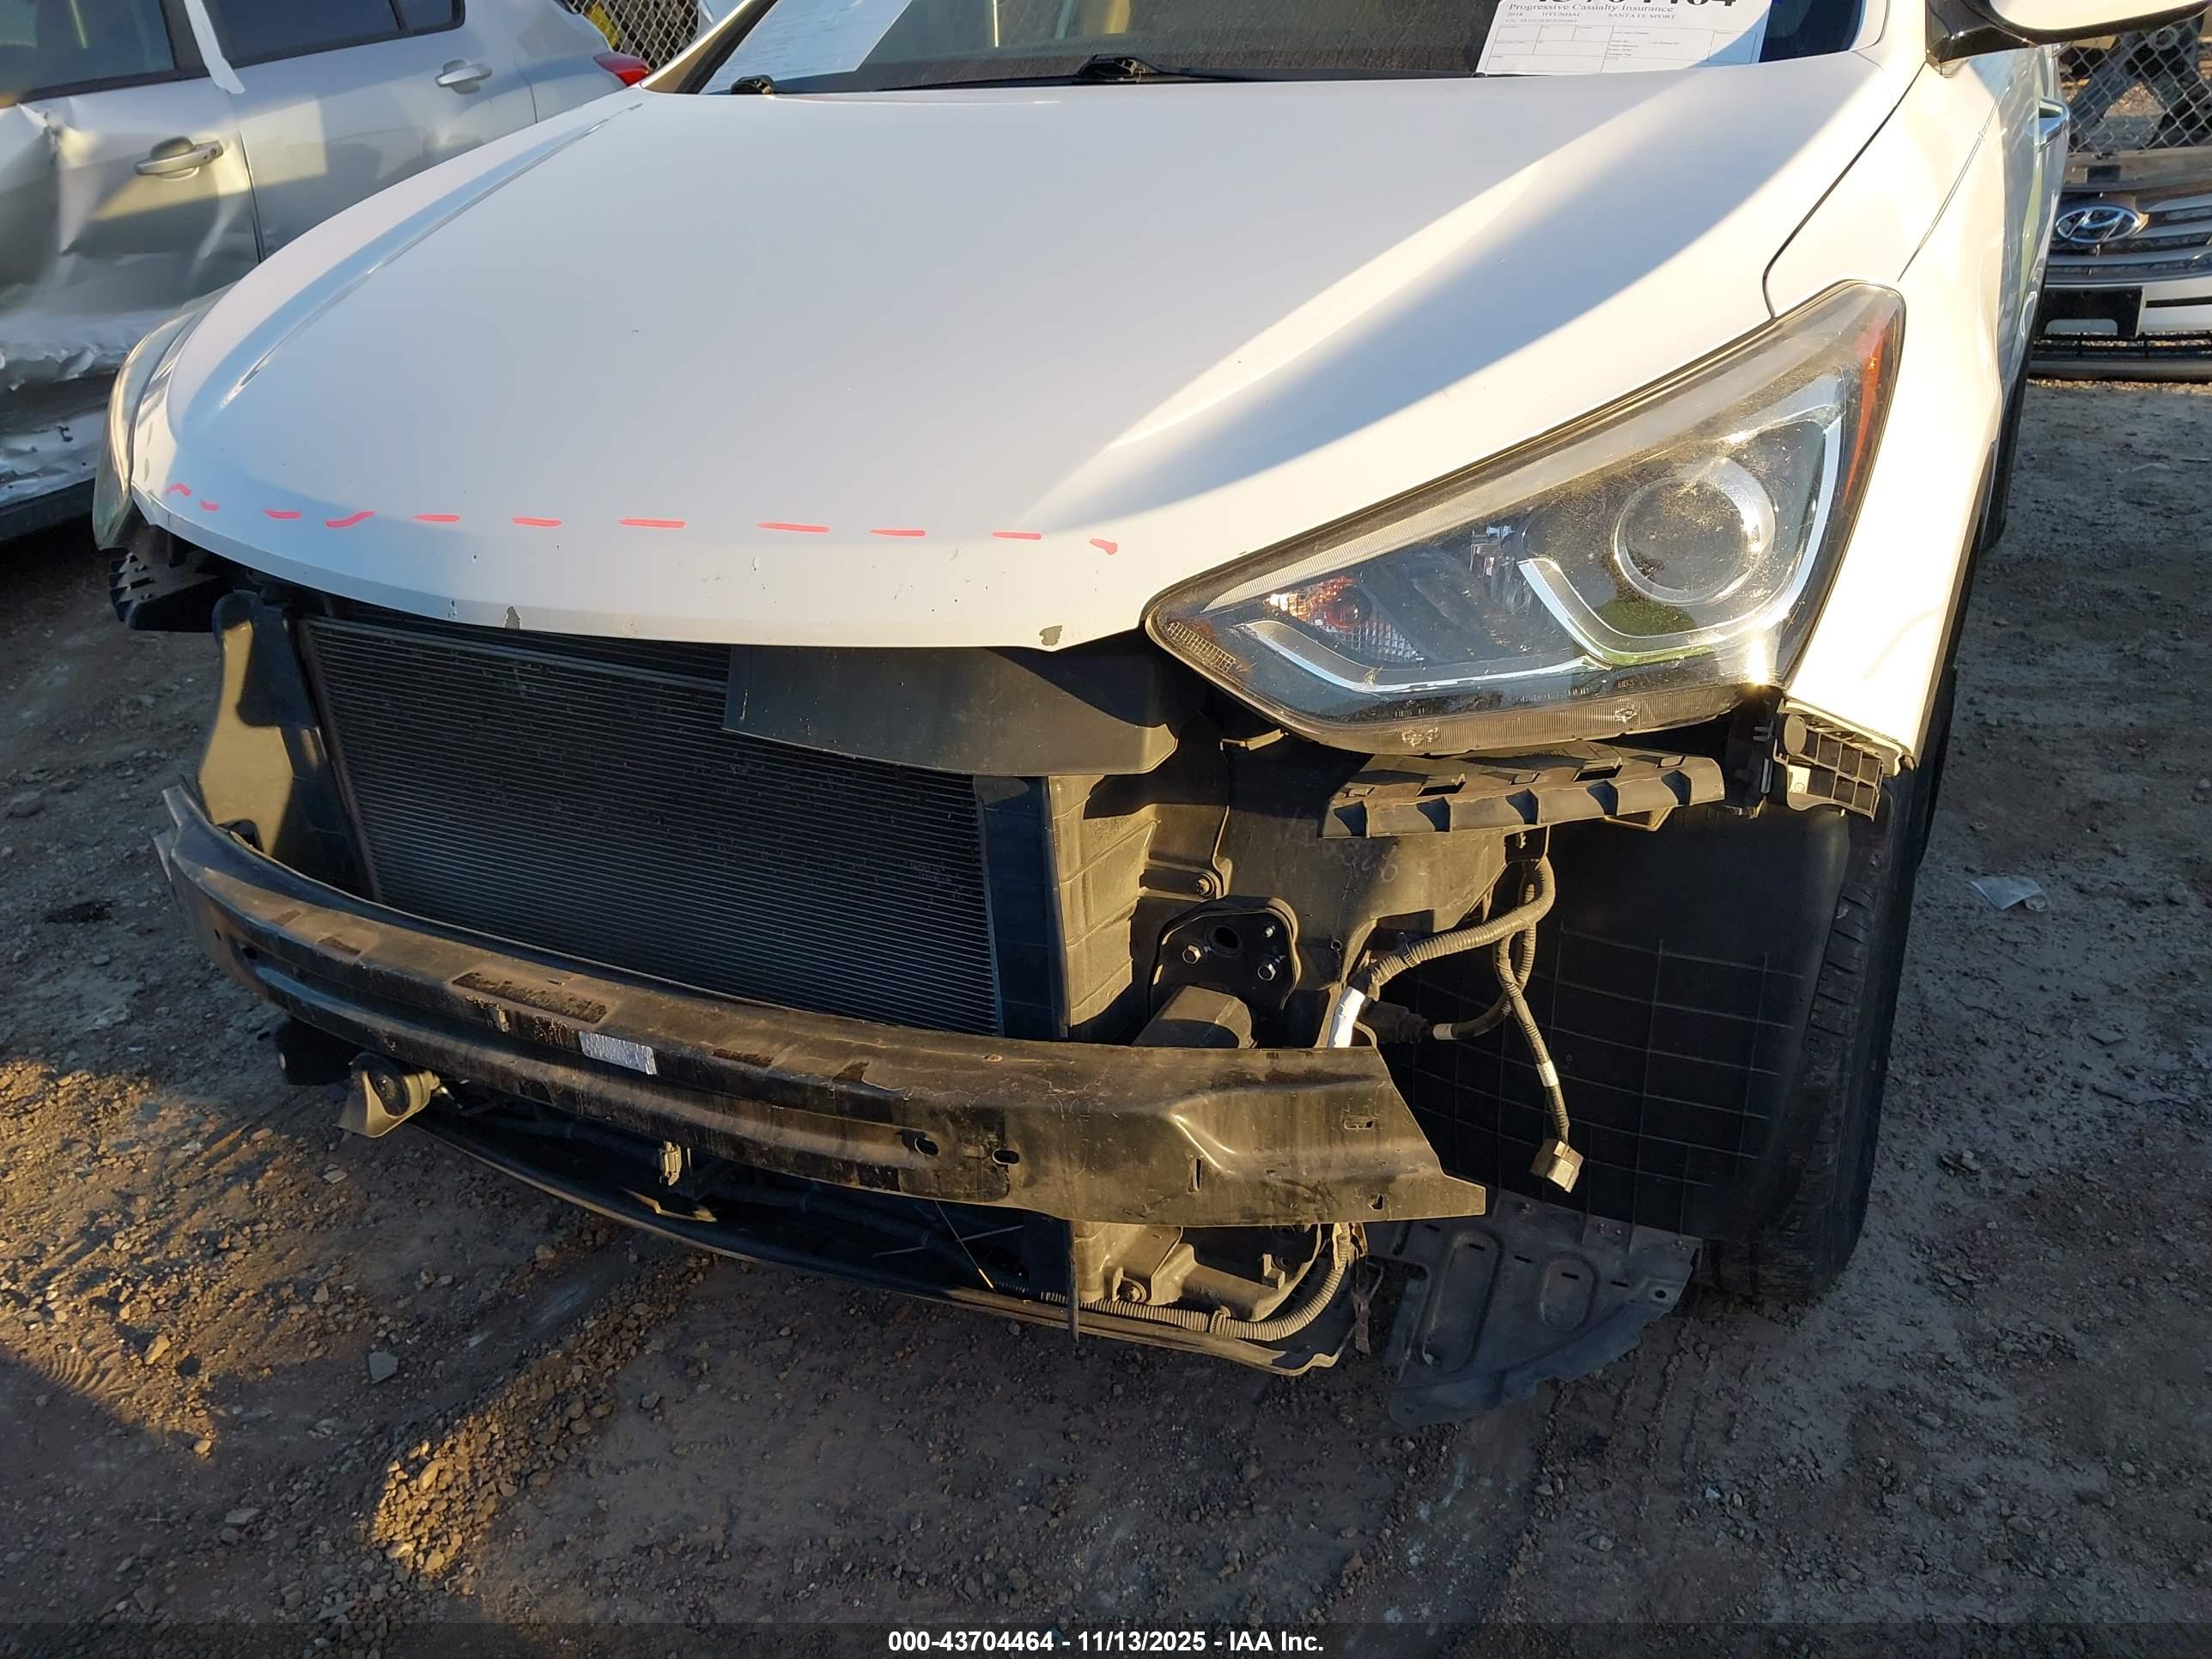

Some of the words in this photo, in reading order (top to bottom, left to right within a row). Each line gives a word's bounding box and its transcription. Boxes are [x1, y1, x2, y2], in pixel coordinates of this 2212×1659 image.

[1509, 3, 1570, 13] Progressive
[1572, 3, 1620, 12] Casualty
[1620, 4, 1674, 13] Insurance
